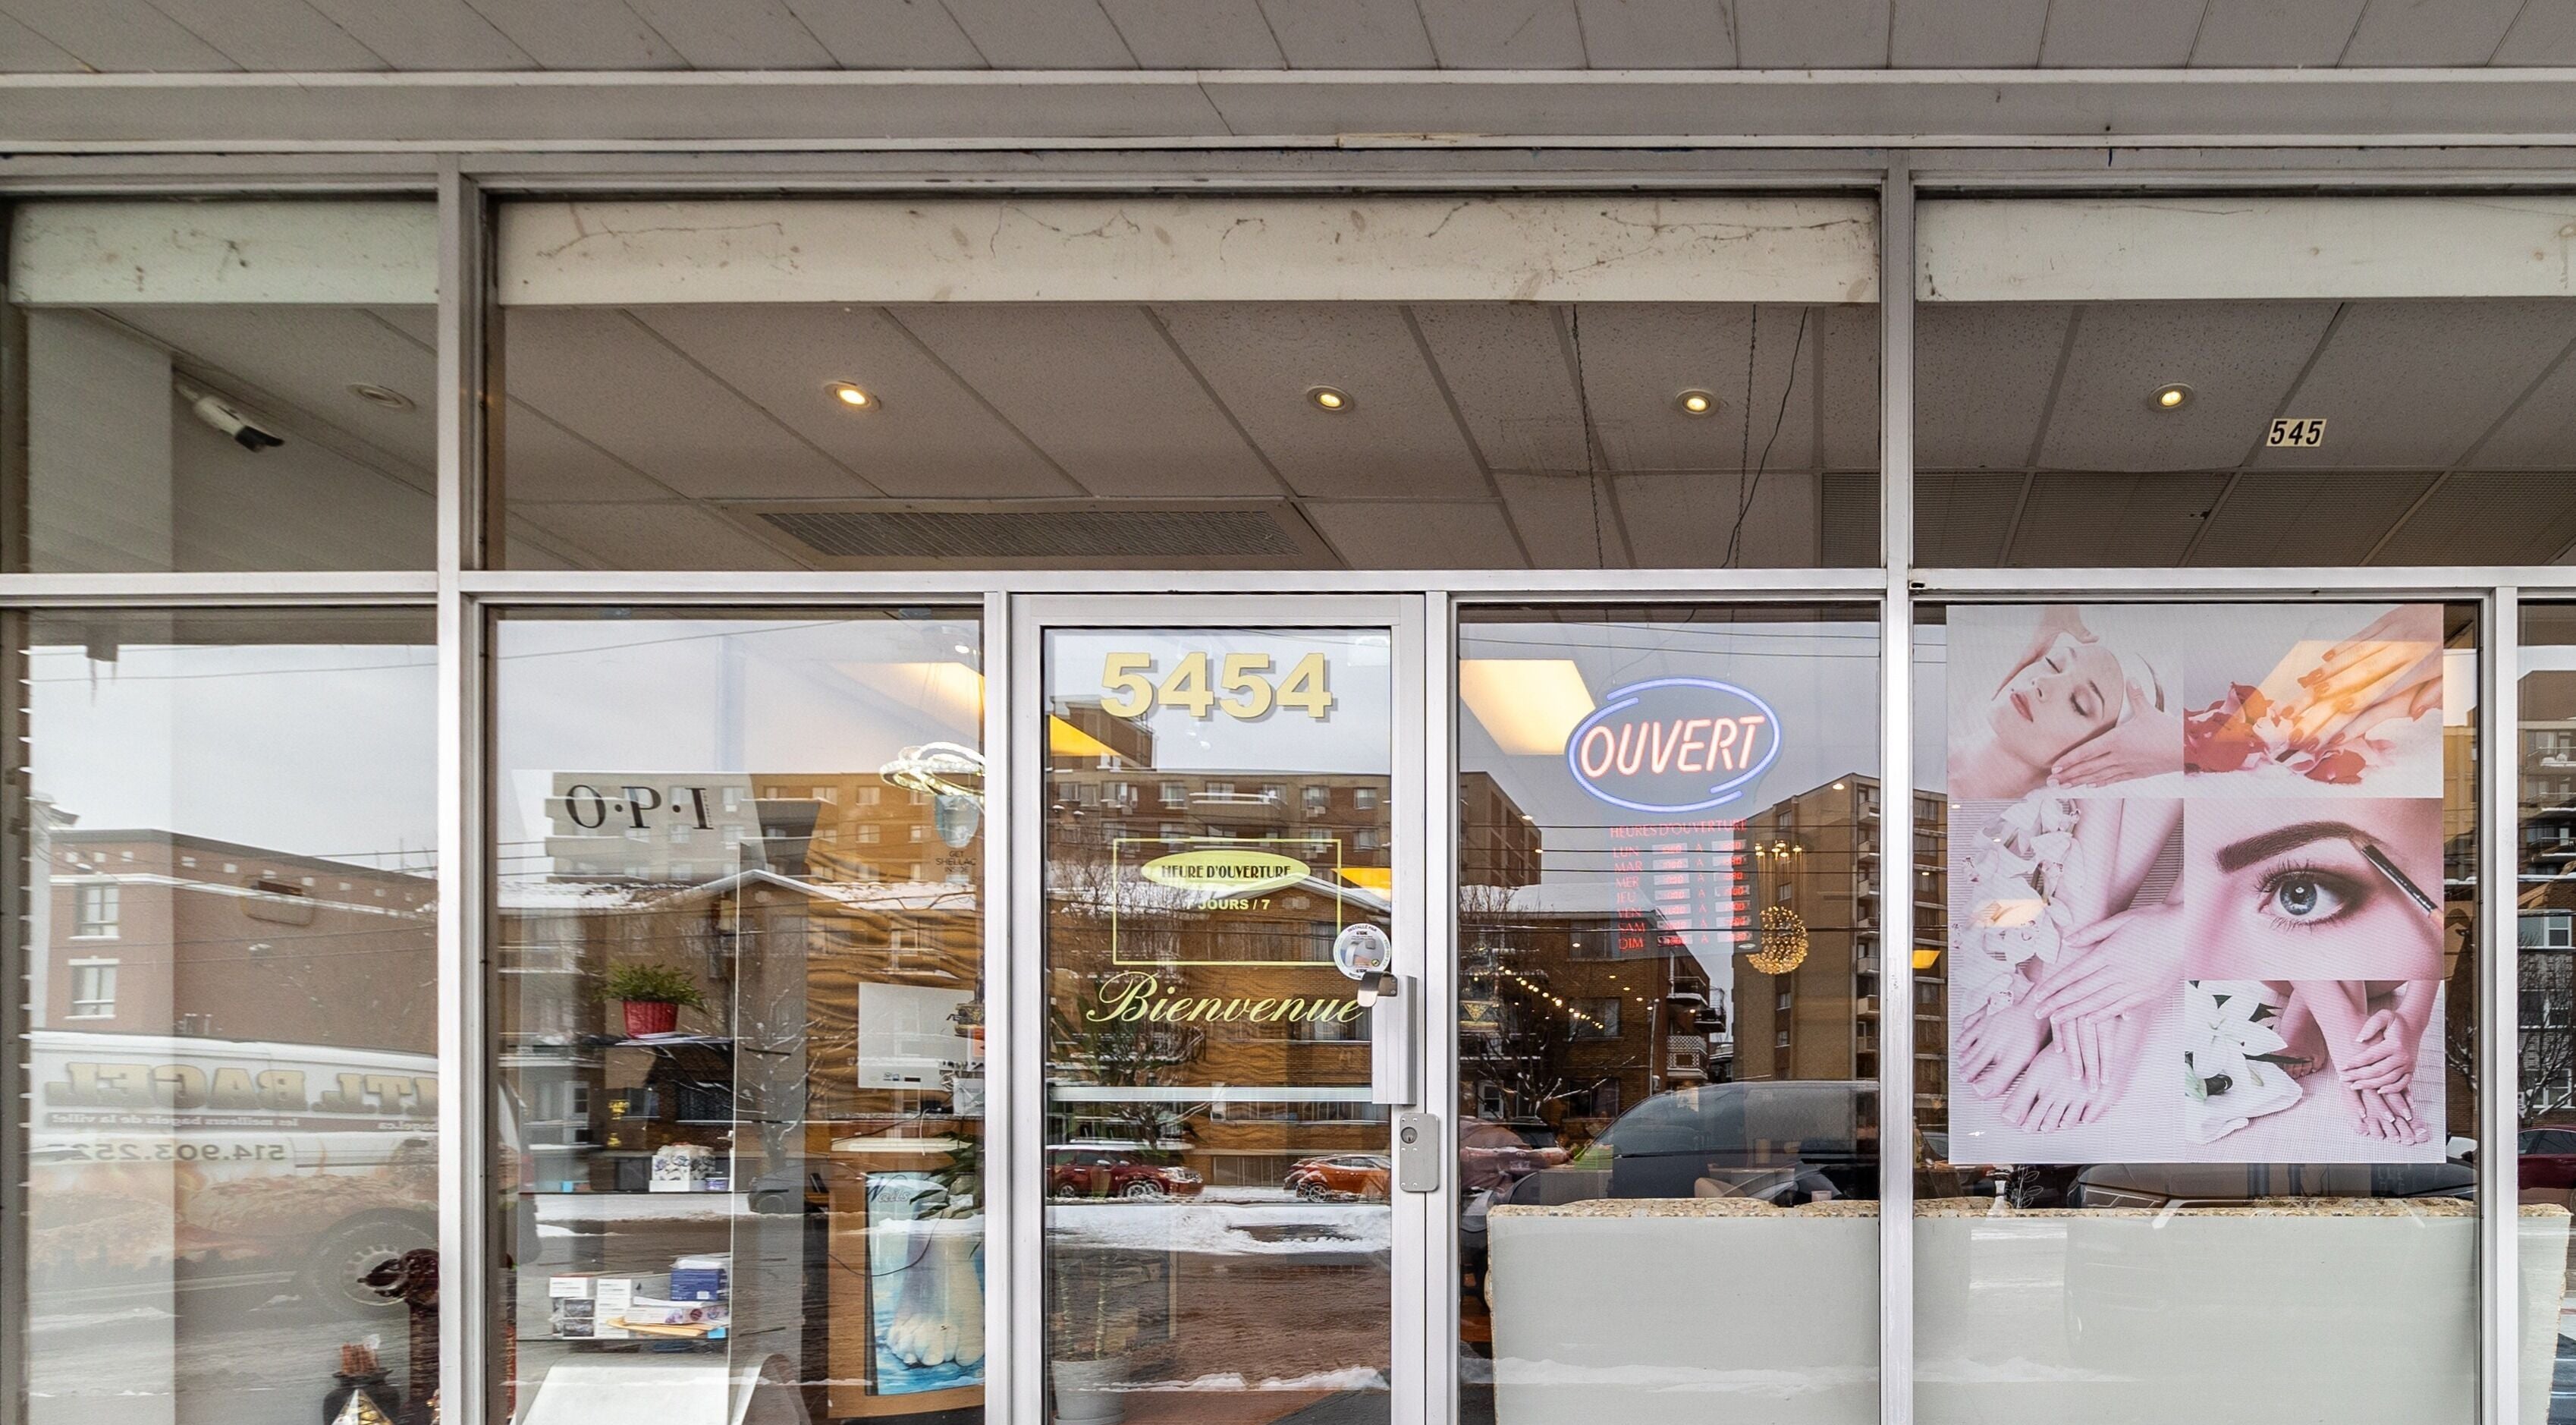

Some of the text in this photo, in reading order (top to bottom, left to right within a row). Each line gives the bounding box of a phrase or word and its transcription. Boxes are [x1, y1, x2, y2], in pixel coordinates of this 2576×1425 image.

[2270, 421, 2323, 445] 545
[1101, 652, 1334, 719] 5454
[1581, 716, 1765, 778] OUVERT
[1610, 824, 1657, 838] HEURES
[1161, 865, 1291, 878] HEURE D'OUVERTURE
[1198, 899, 1249, 910] JOURS
[1261, 899, 1271, 910] 7
[1086, 971, 1364, 1023] Bienvenue
